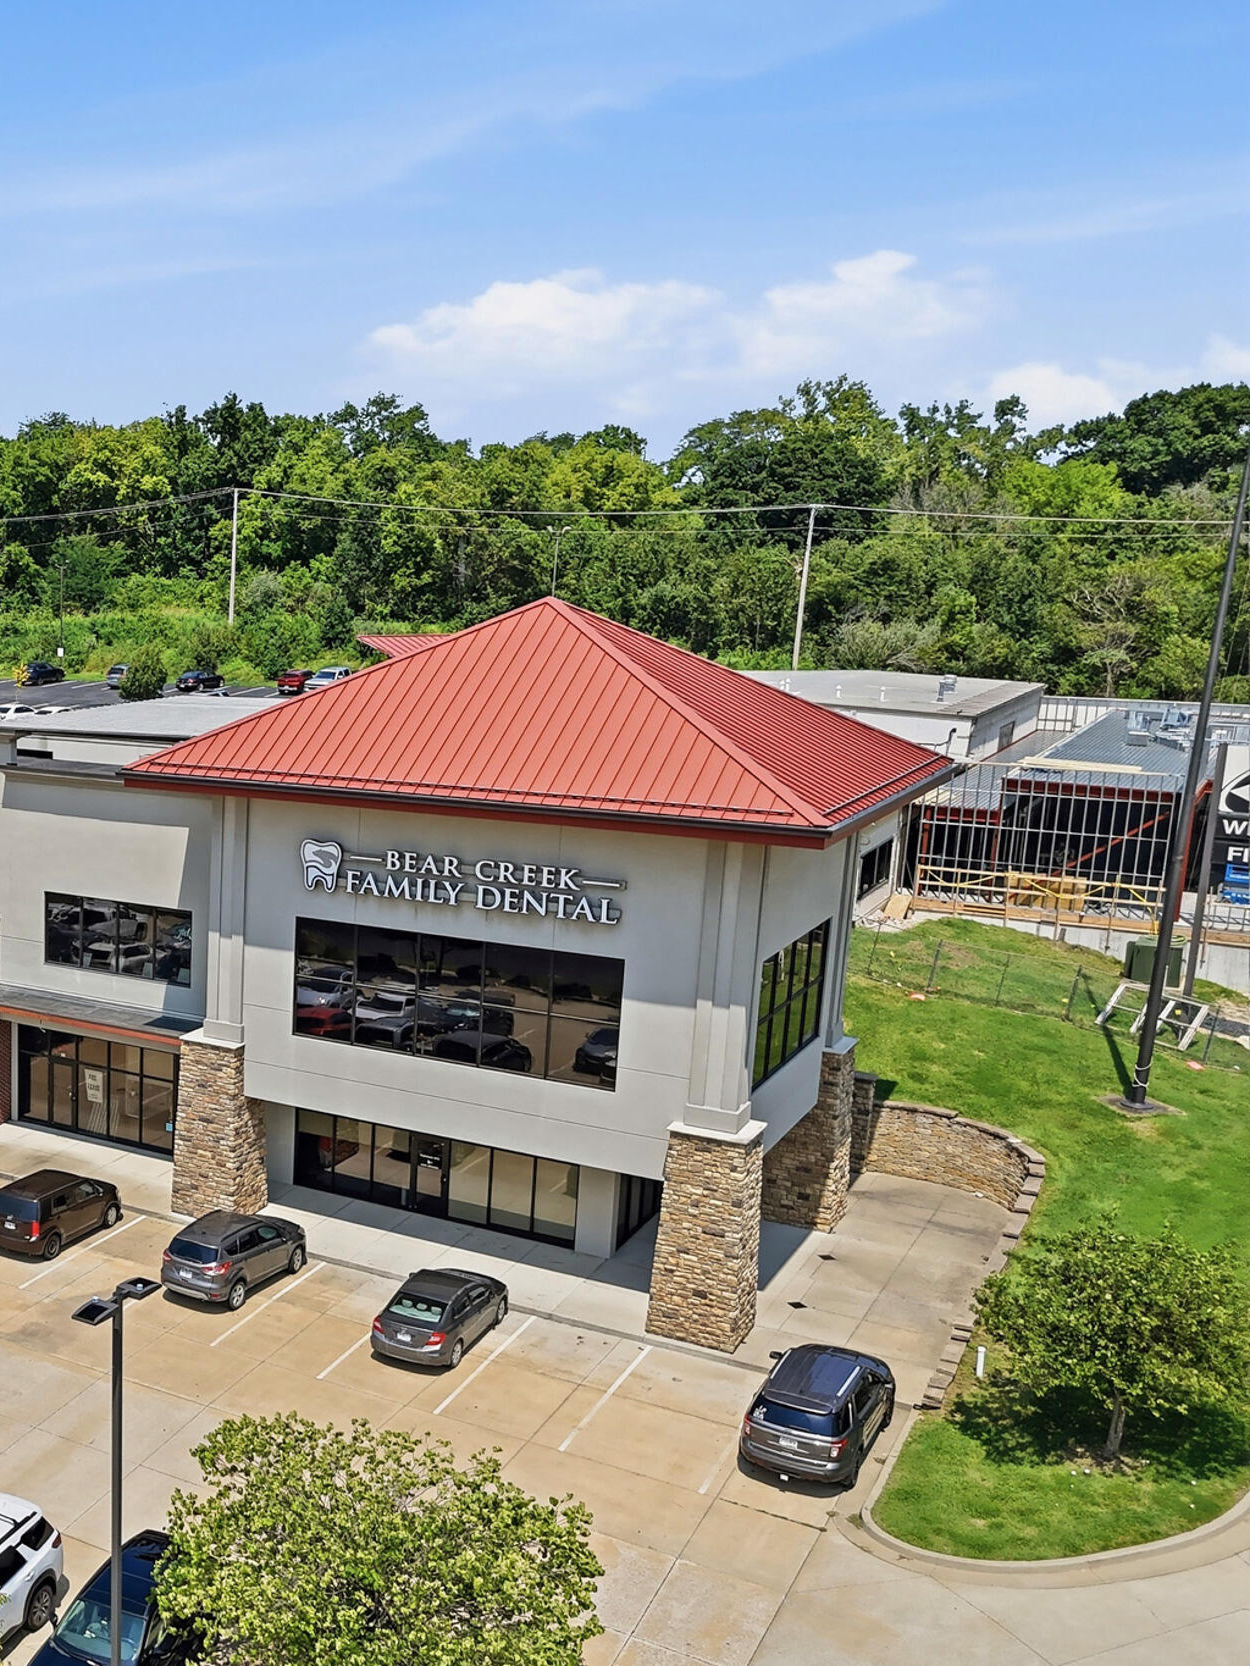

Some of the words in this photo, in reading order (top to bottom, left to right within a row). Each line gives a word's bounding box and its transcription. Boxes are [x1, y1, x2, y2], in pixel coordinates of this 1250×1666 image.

[385, 849, 463, 879] BEAR
[474, 858, 581, 891] CREEK
[345, 869, 466, 907] FAMILY
[474, 884, 622, 926] DENTAL
